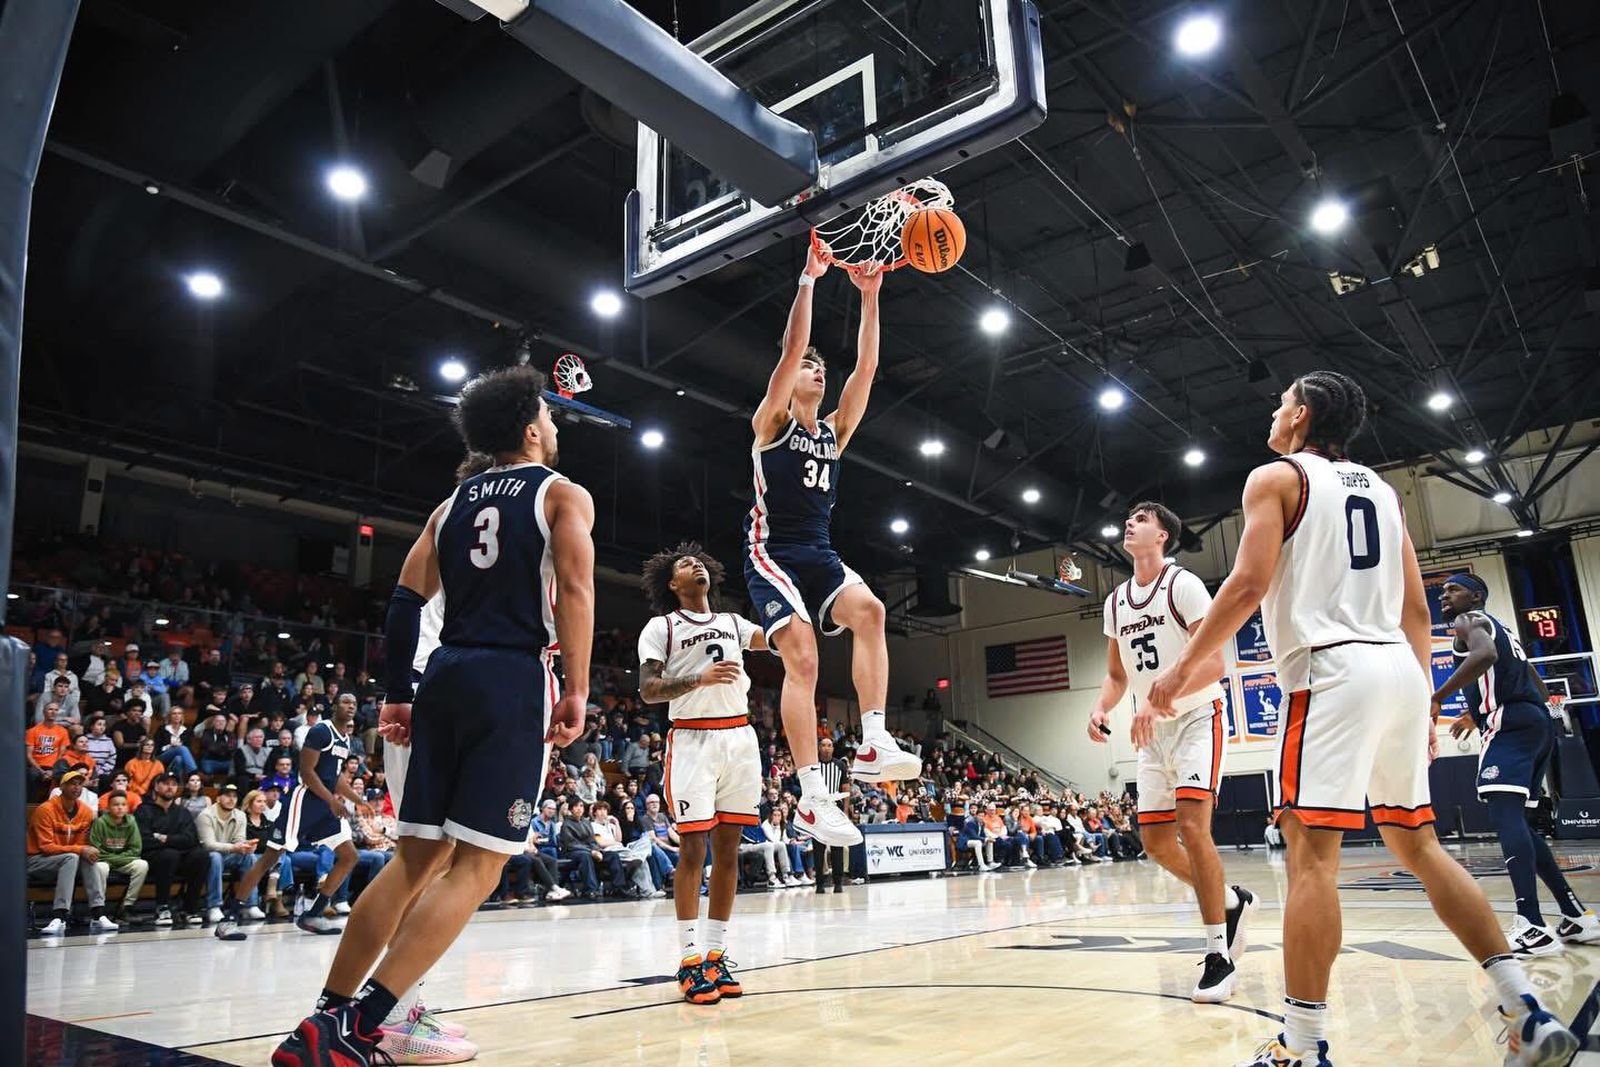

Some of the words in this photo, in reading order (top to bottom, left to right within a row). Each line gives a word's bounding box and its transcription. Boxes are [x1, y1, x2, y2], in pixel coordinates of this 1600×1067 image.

[934, 228, 950, 269] Wilson
[803, 459, 831, 492] 34
[468, 477, 527, 502] SMITH
[469, 506, 501, 570] 3
[1345, 494, 1381, 570] 0
[1120, 614, 1165, 637] PEPPERDINE
[1538, 620, 1556, 637] 13
[681, 628, 736, 650] PEPPERDINE
[1131, 632, 1160, 672] 35
[677, 800, 690, 816] P
[886, 845, 904, 857] WCC
[909, 848, 942, 856] UNIVERSITY
